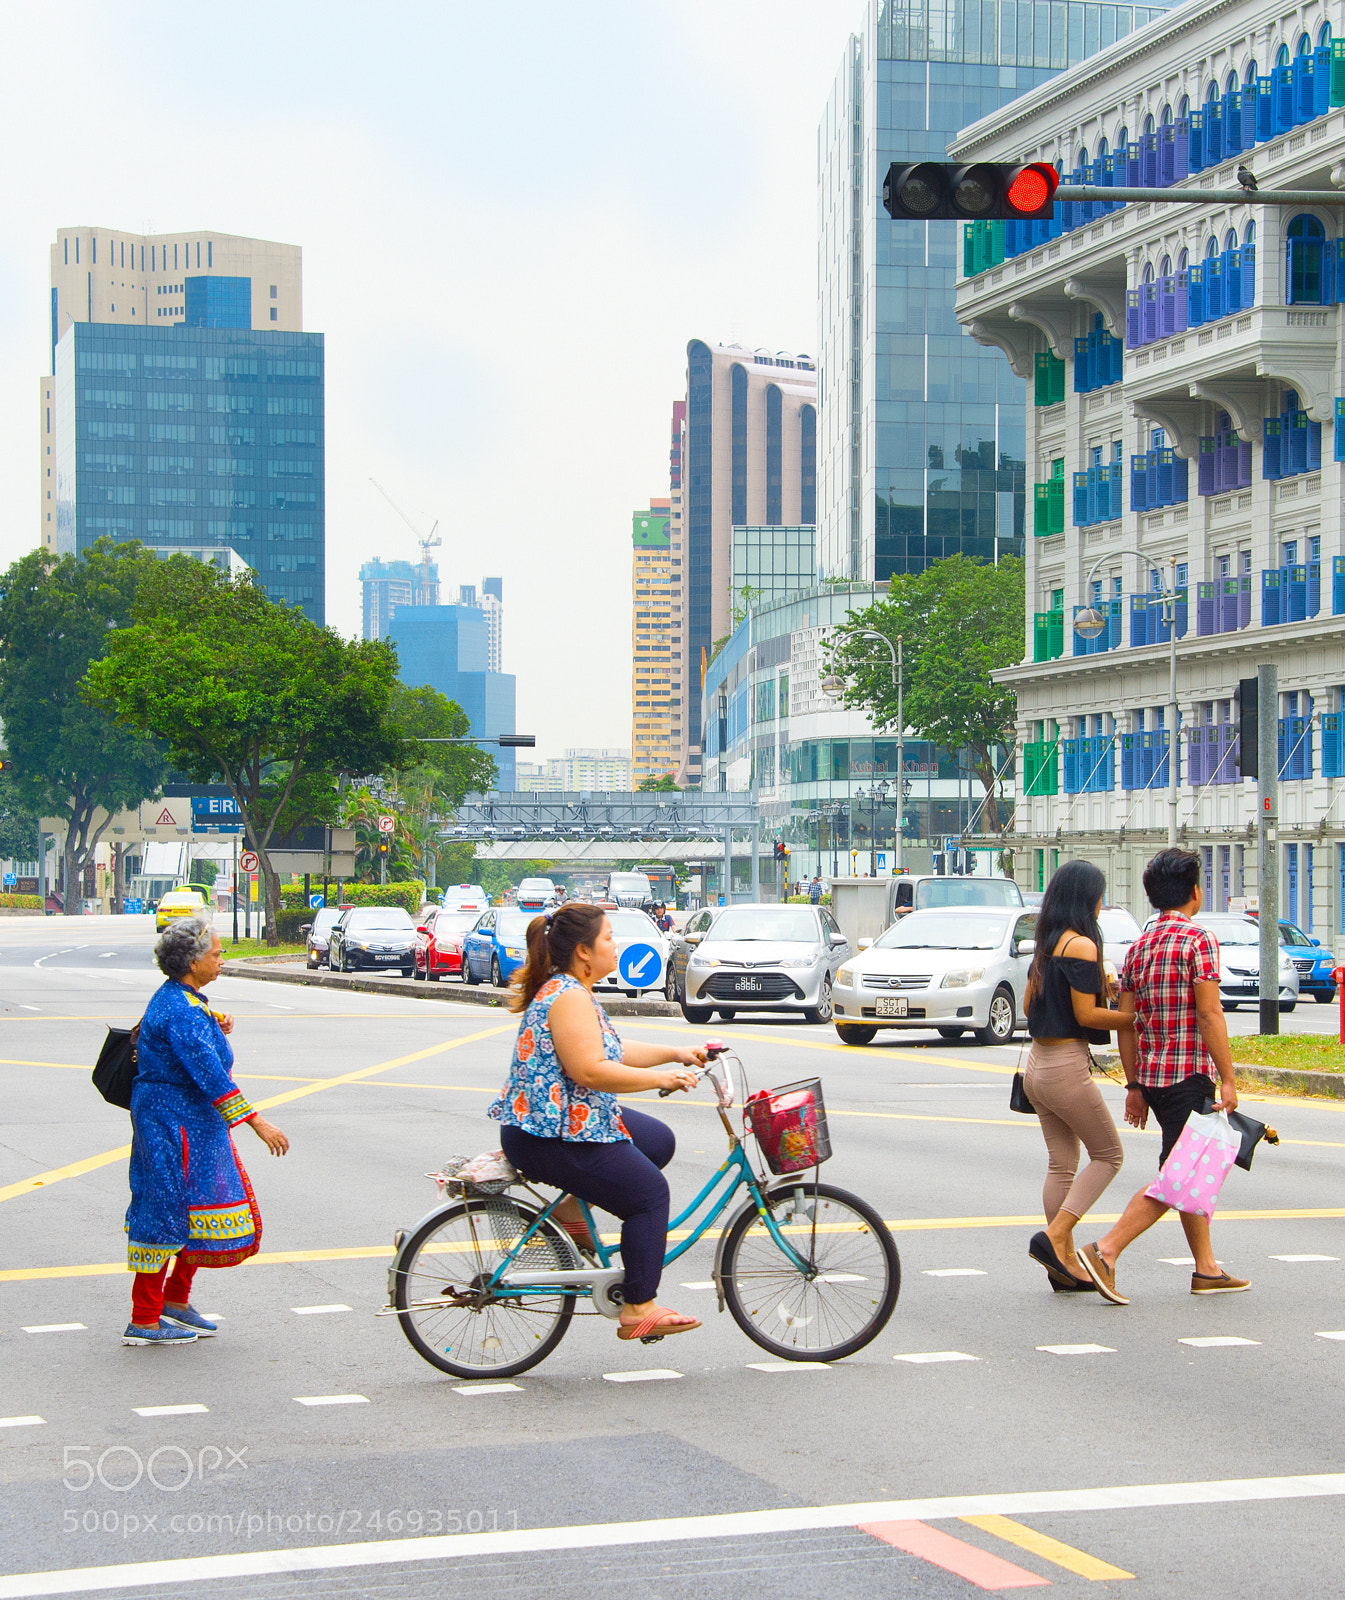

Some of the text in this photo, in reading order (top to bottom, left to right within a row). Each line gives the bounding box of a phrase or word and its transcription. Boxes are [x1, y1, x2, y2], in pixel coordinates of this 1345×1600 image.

[850, 760, 939, 772] Kublai Khan
[1264, 797, 1271, 811] 6
[883, 998, 900, 1006] SGT
[877, 1006, 907, 1015] 2324P
